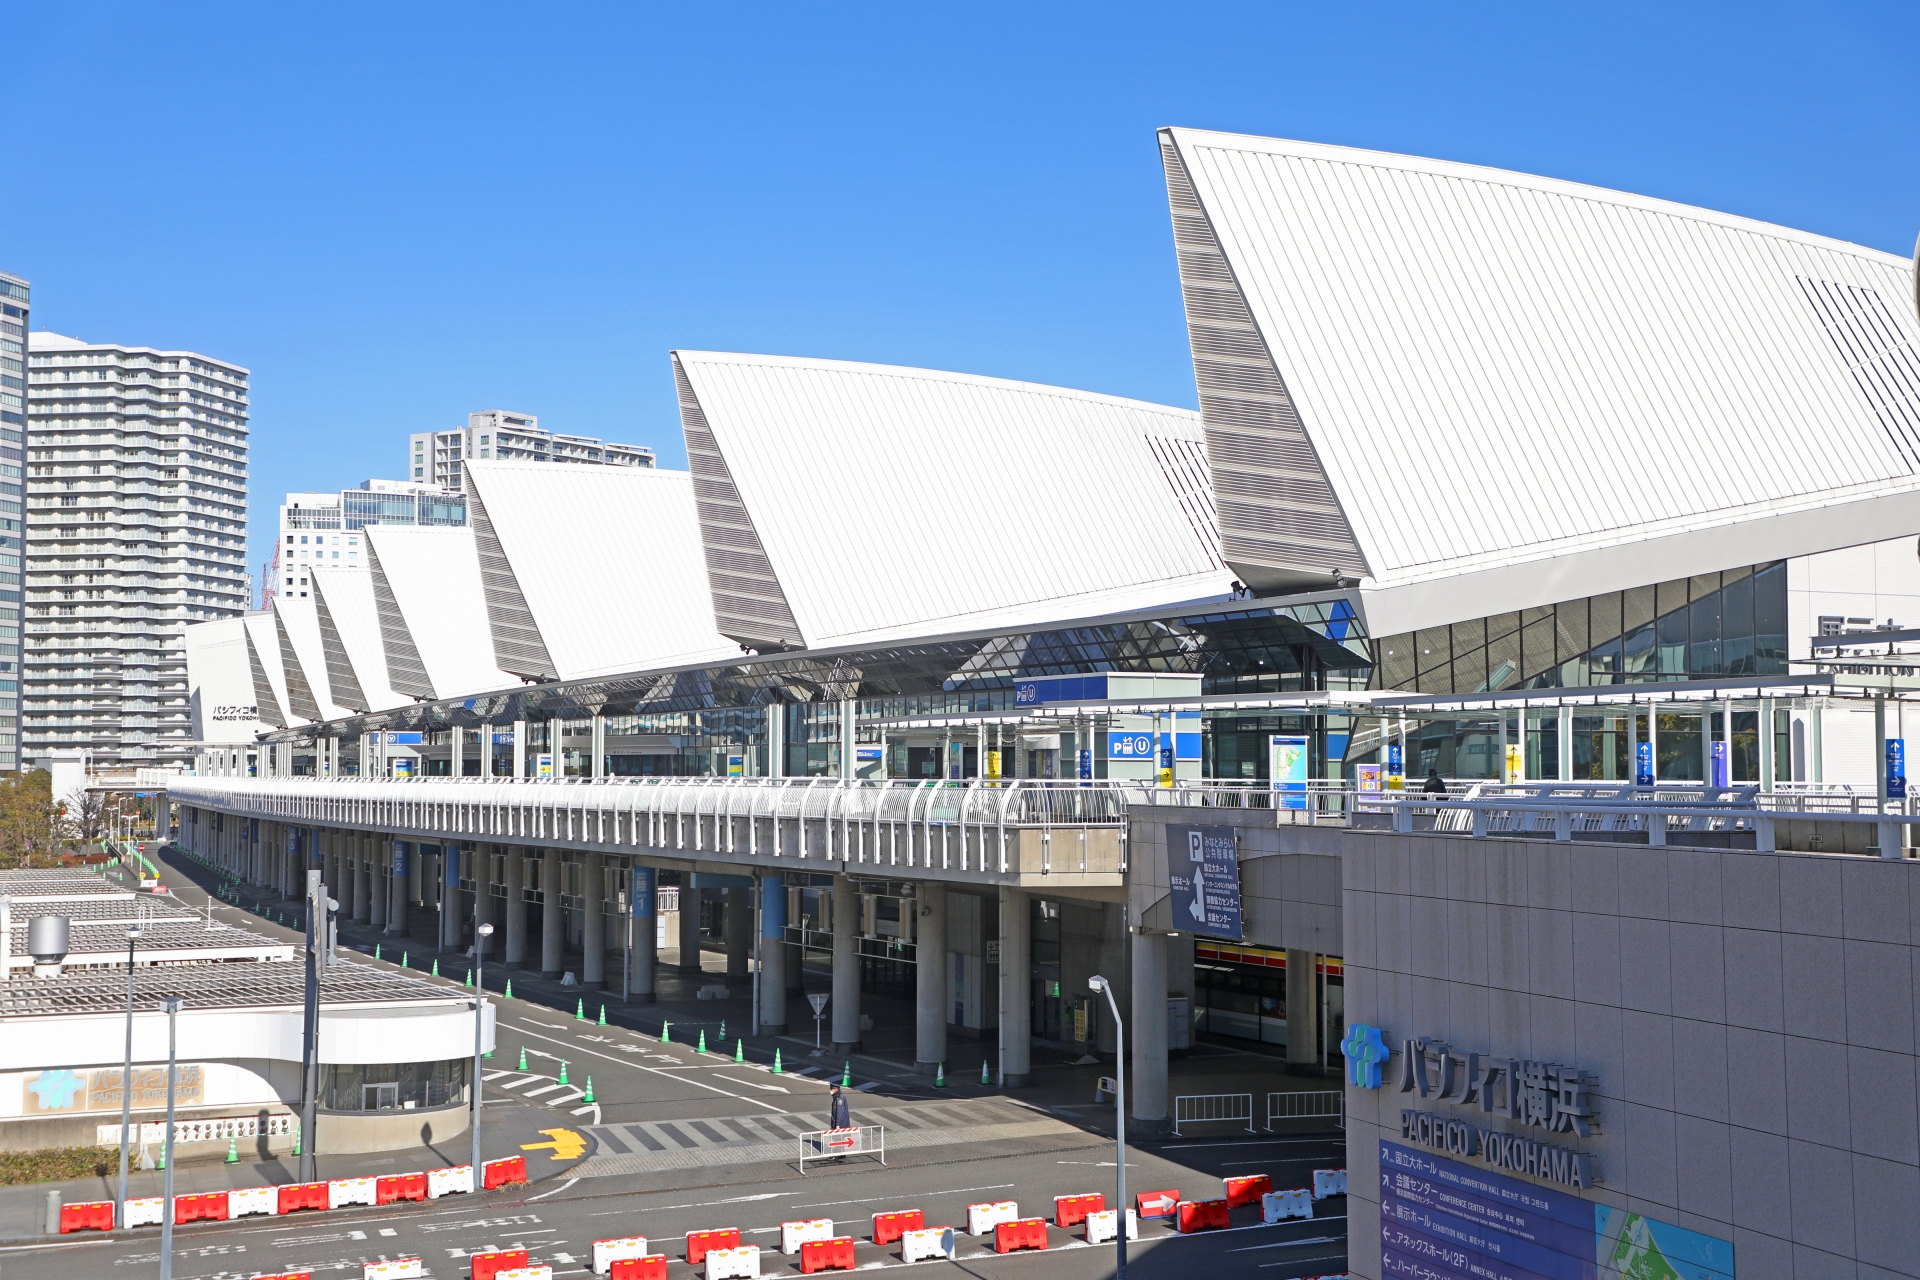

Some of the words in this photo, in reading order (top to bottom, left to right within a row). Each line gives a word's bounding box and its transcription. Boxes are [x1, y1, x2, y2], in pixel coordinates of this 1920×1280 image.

[1017, 692, 1021, 702] P
[1114, 742, 1122, 754] P
[1192, 835, 1200, 858] P
[396, 863, 402, 871] 2
[638, 899, 644, 909] 1
[1400, 1036, 1591, 1138] パシフィコ横浜
[1400, 1108, 1475, 1156] PACIFICO
[1478, 1129, 1588, 1188] YOKOHAMA
[1396, 1151, 1437, 1174] 国立大ホール
[1396, 1173, 1438, 1194] 会議センター
[1439, 1170, 1459, 1183] NATIONAL
[1460, 1176, 1488, 1192] CONVENTION
[1488, 1185, 1500, 1196] HALL
[1440, 1192, 1467, 1208] CONFERENCE
[1468, 1203, 1484, 1214] CENTER
[1396, 1204, 1431, 1228] 展示ホール
[1433, 1224, 1455, 1238] EXHIBITION
[1456, 1232, 1467, 1242] HALL
[1396, 1232, 1468, 1270] アネックスホール(2F)
[1470, 1264, 1485, 1276] ANNEX
